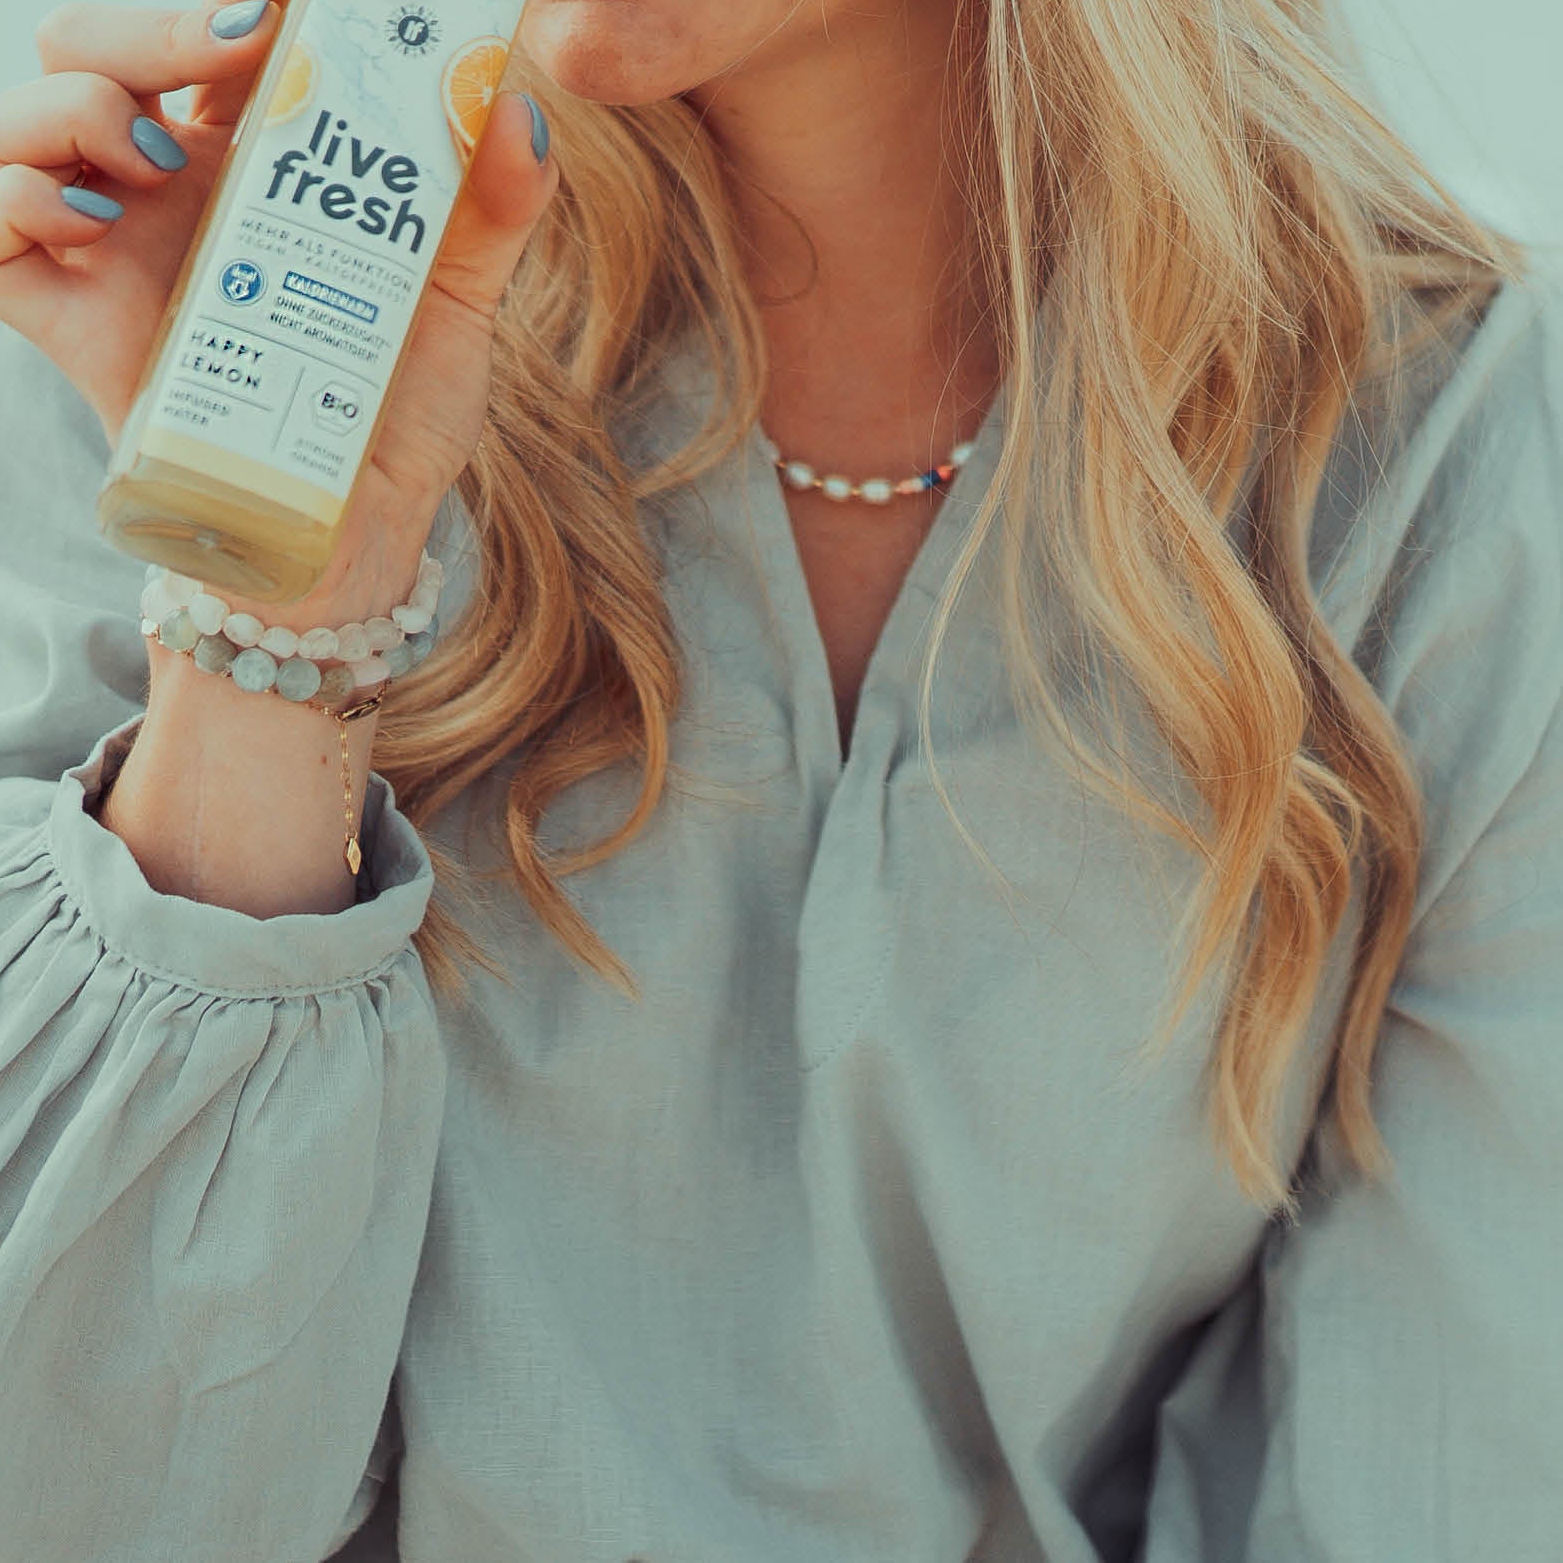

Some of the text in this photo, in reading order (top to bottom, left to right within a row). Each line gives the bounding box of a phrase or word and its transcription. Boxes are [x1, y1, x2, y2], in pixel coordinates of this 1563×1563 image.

[308, 109, 420, 194] live
[265, 149, 426, 254] fresh
[181, 353, 262, 390] LEMON
[190, 330, 264, 364] HAPPY
